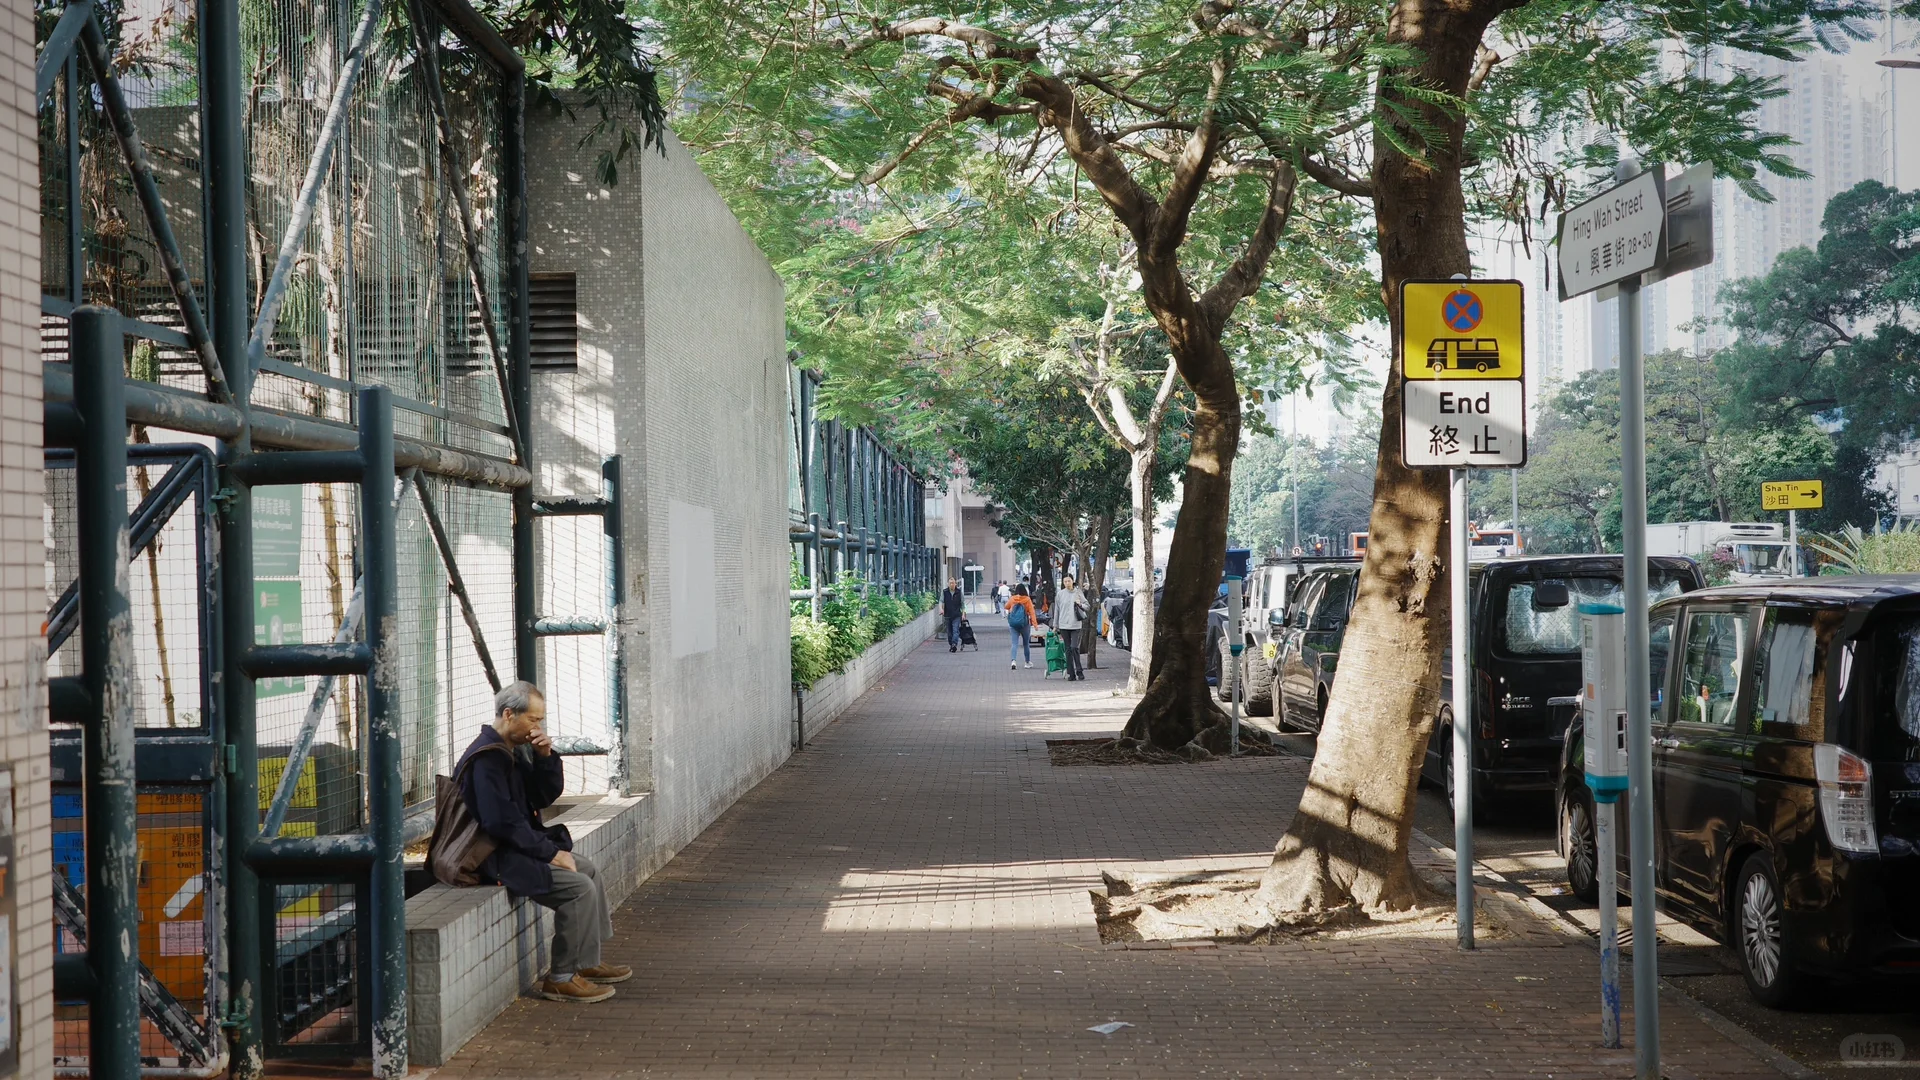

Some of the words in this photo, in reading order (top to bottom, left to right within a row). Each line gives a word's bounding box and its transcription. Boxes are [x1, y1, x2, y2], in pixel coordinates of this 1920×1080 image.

[1573, 217, 1592, 241] Hing
[1593, 204, 1612, 231] Wah
[1614, 189, 1644, 222] Street
[1575, 260, 1580, 275] 4
[1590, 236, 1625, 276] 興華街
[1439, 391, 1490, 415] End
[1429, 424, 1501, 456] 終止
[1765, 484, 1782, 492] Sha
[1765, 494, 1789, 506] 沙田
[171, 849, 201, 858] Plastics
